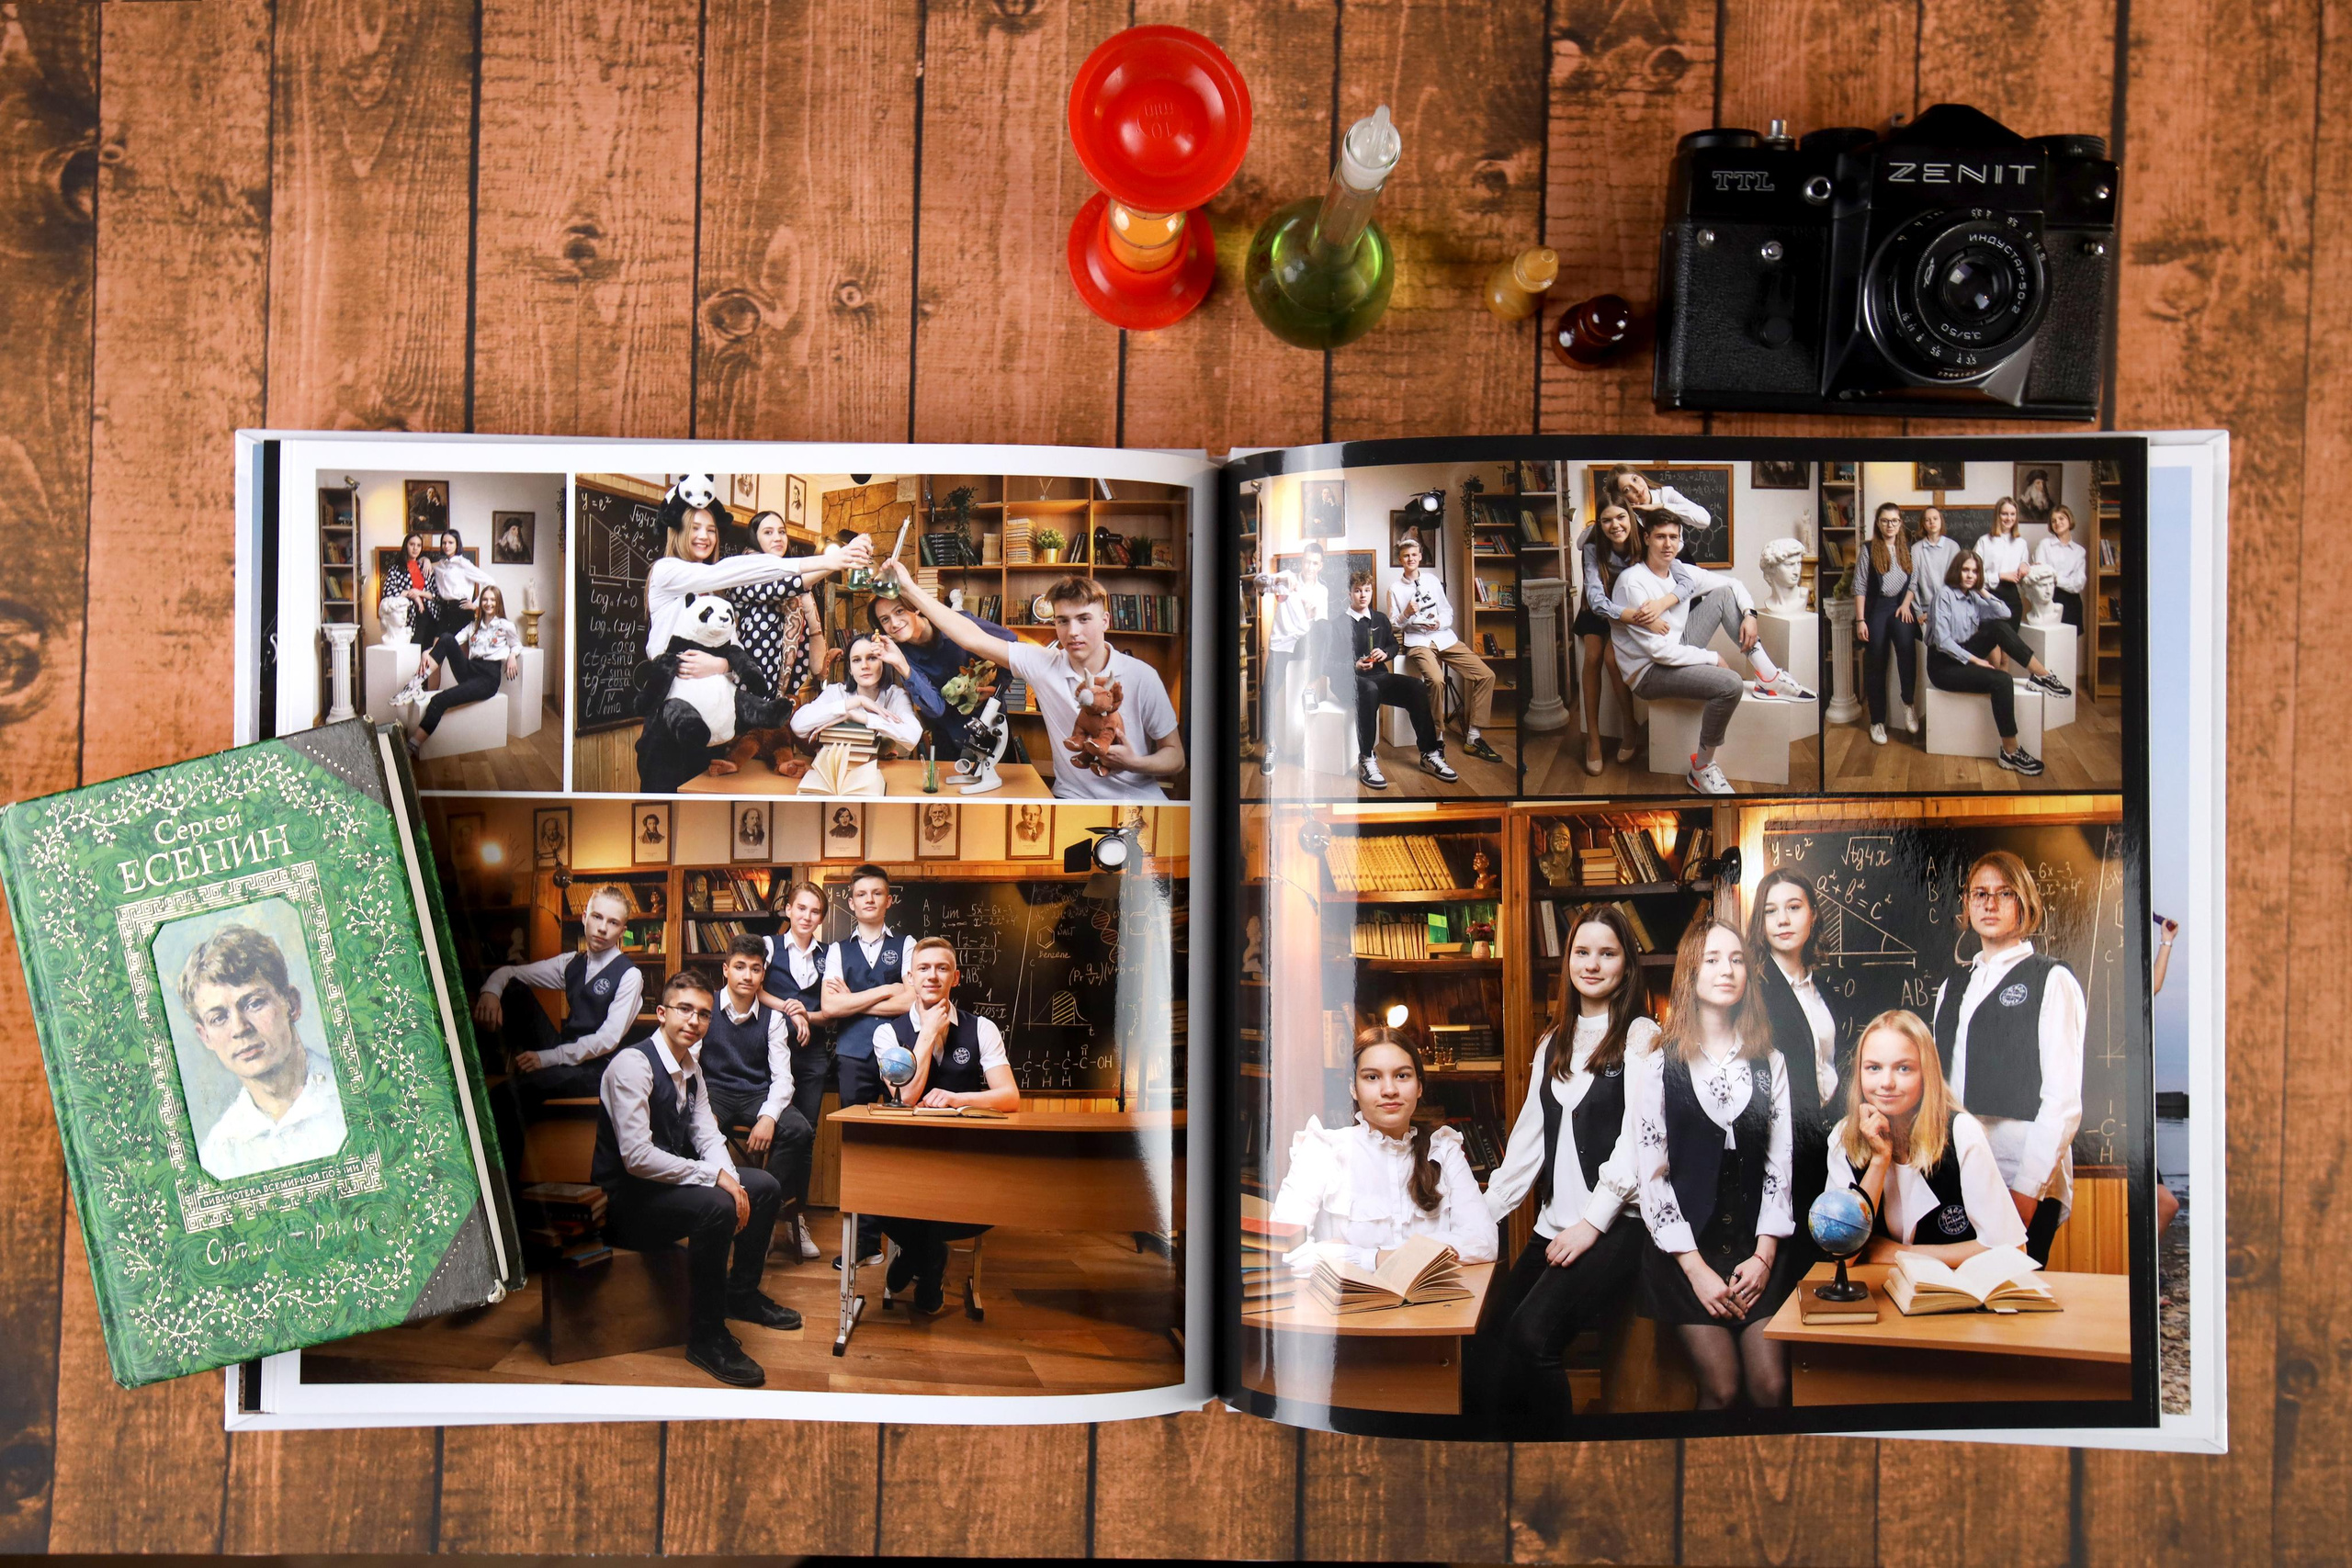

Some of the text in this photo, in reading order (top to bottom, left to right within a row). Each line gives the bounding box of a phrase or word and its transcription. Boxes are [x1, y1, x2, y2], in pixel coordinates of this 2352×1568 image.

[1712, 171, 1775, 191] TTL
[1888, 162, 2037, 185] ZENIT
[1969, 234, 2027, 314] ИНДУСТАР-50-2
[154, 805, 243, 845] Сергей
[117, 823, 294, 896] ЕСЕНИН
[1926, 855, 1938, 877] A
[1928, 881, 1939, 902] B
[922, 898, 931, 912] A
[923, 914, 931, 928] B
